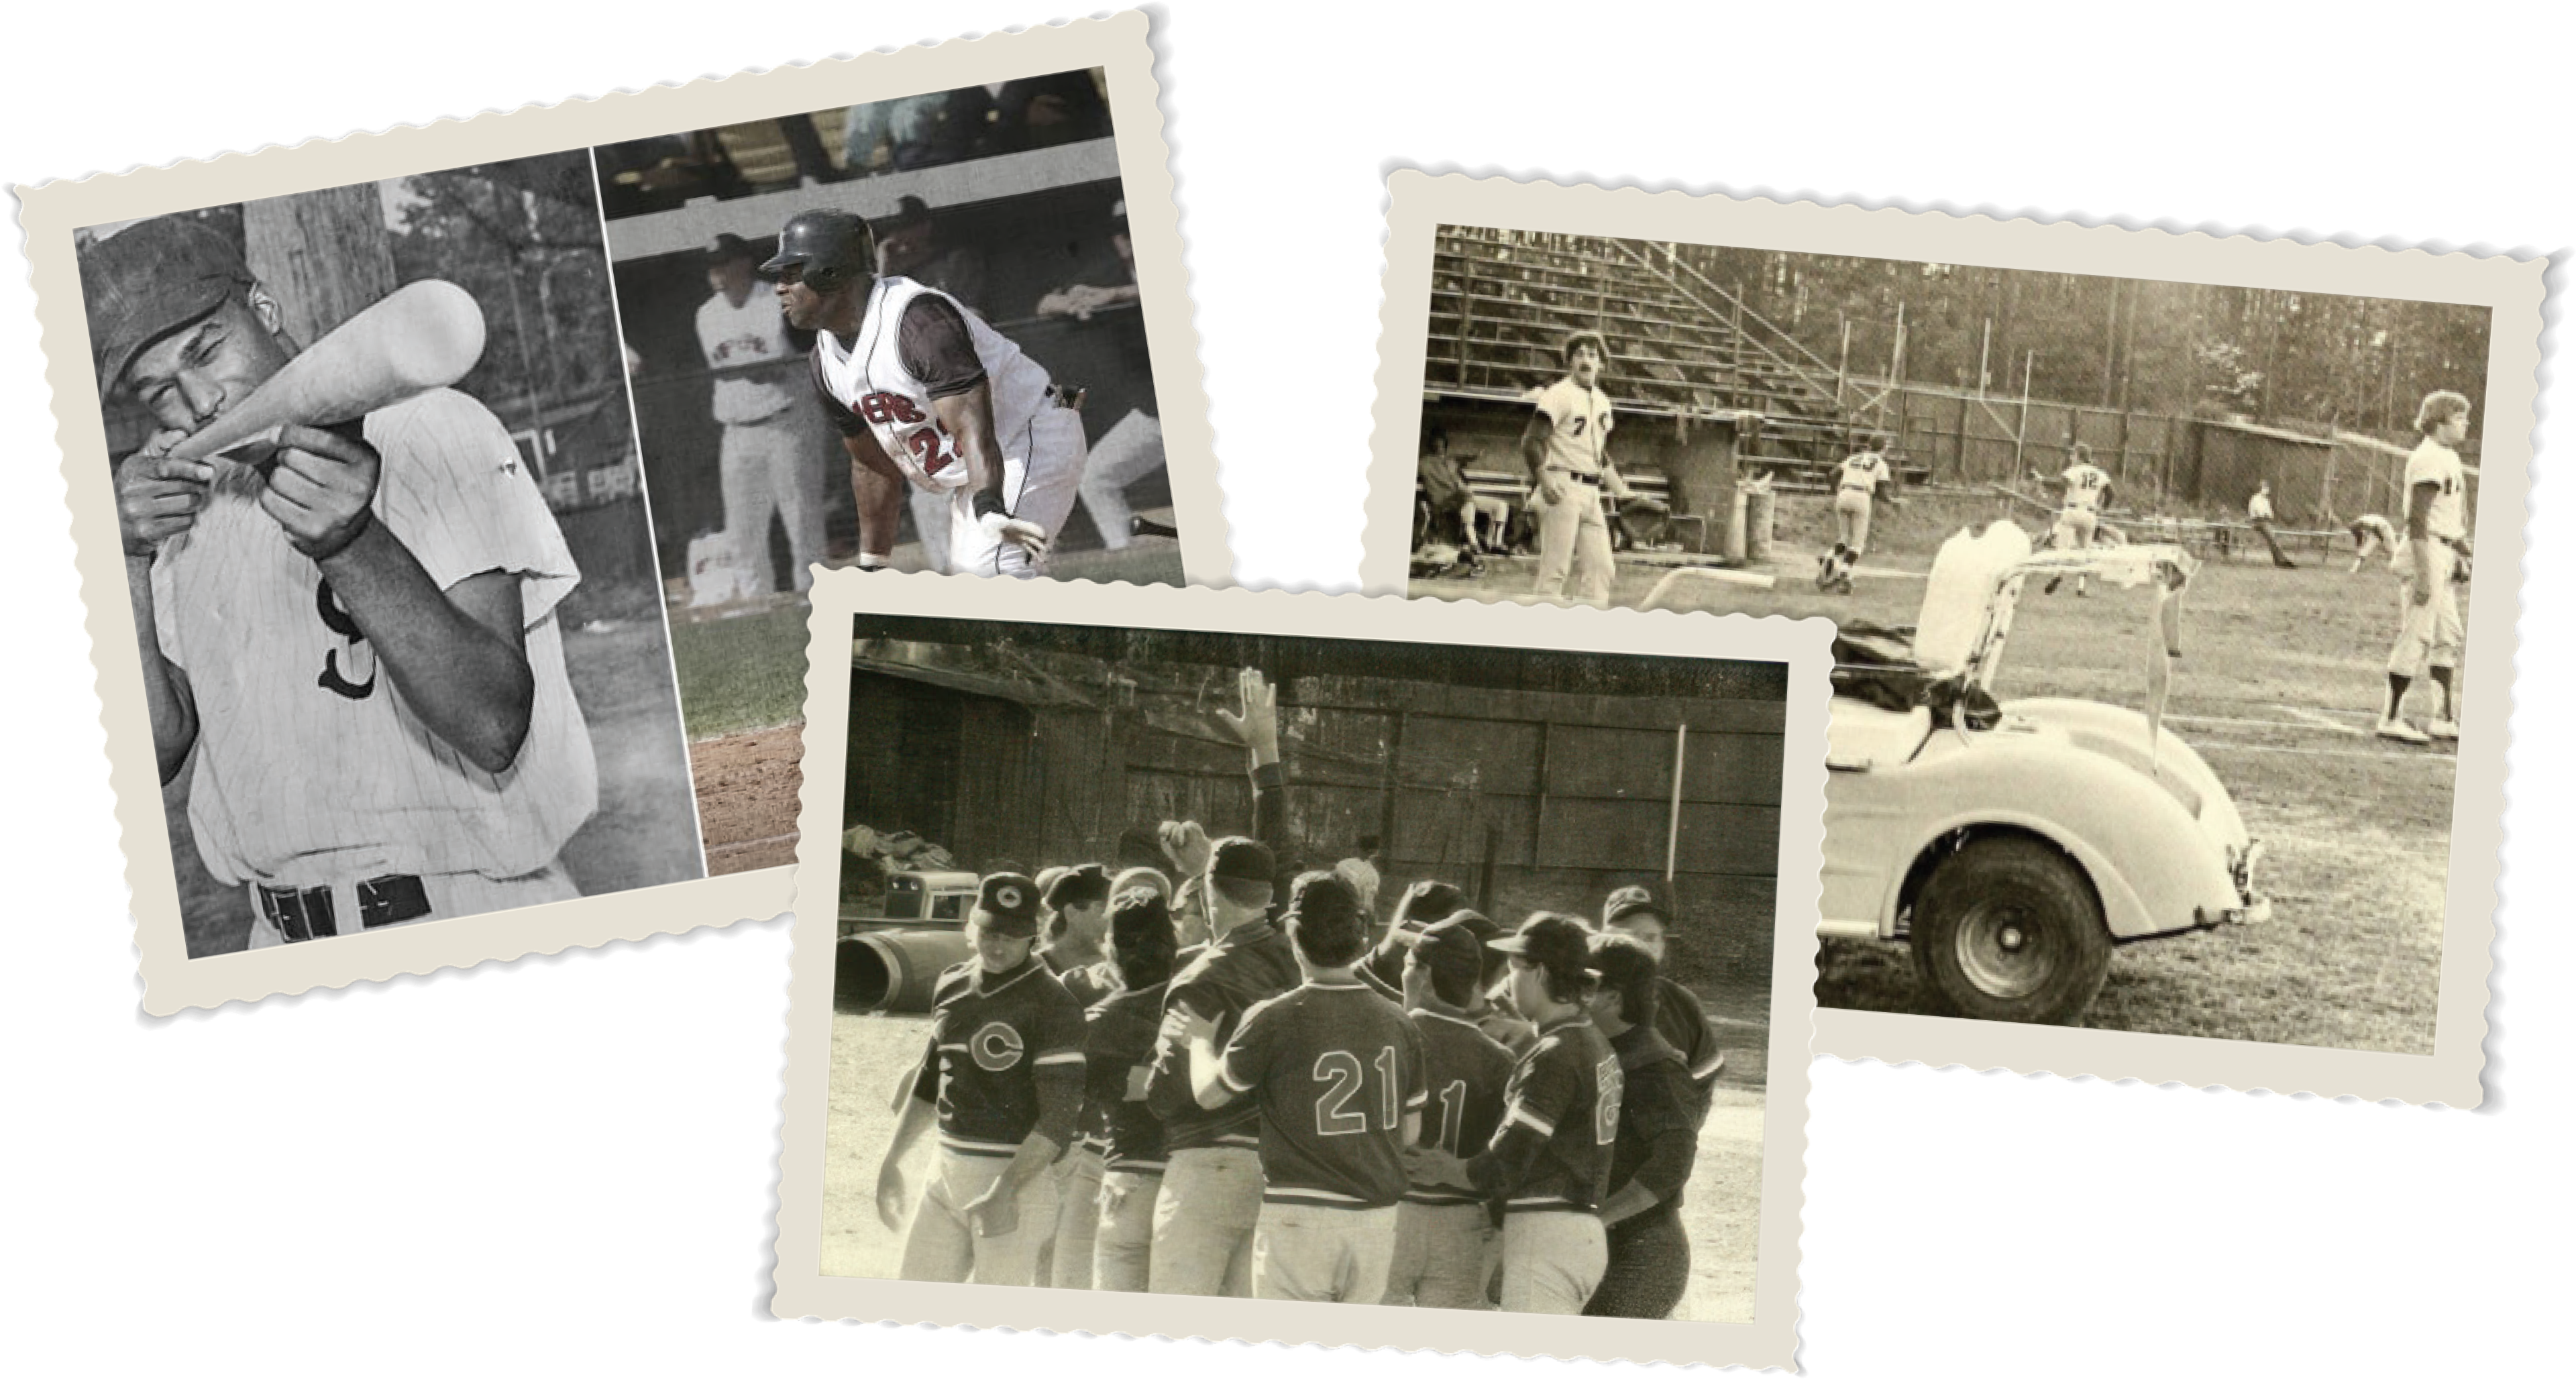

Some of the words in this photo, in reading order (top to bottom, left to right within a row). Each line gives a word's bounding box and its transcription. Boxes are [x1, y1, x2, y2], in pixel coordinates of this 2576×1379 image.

[1573, 415, 1587, 436] 7
[970, 1022, 1024, 1071] C
[1313, 1046, 1398, 1136] 21
